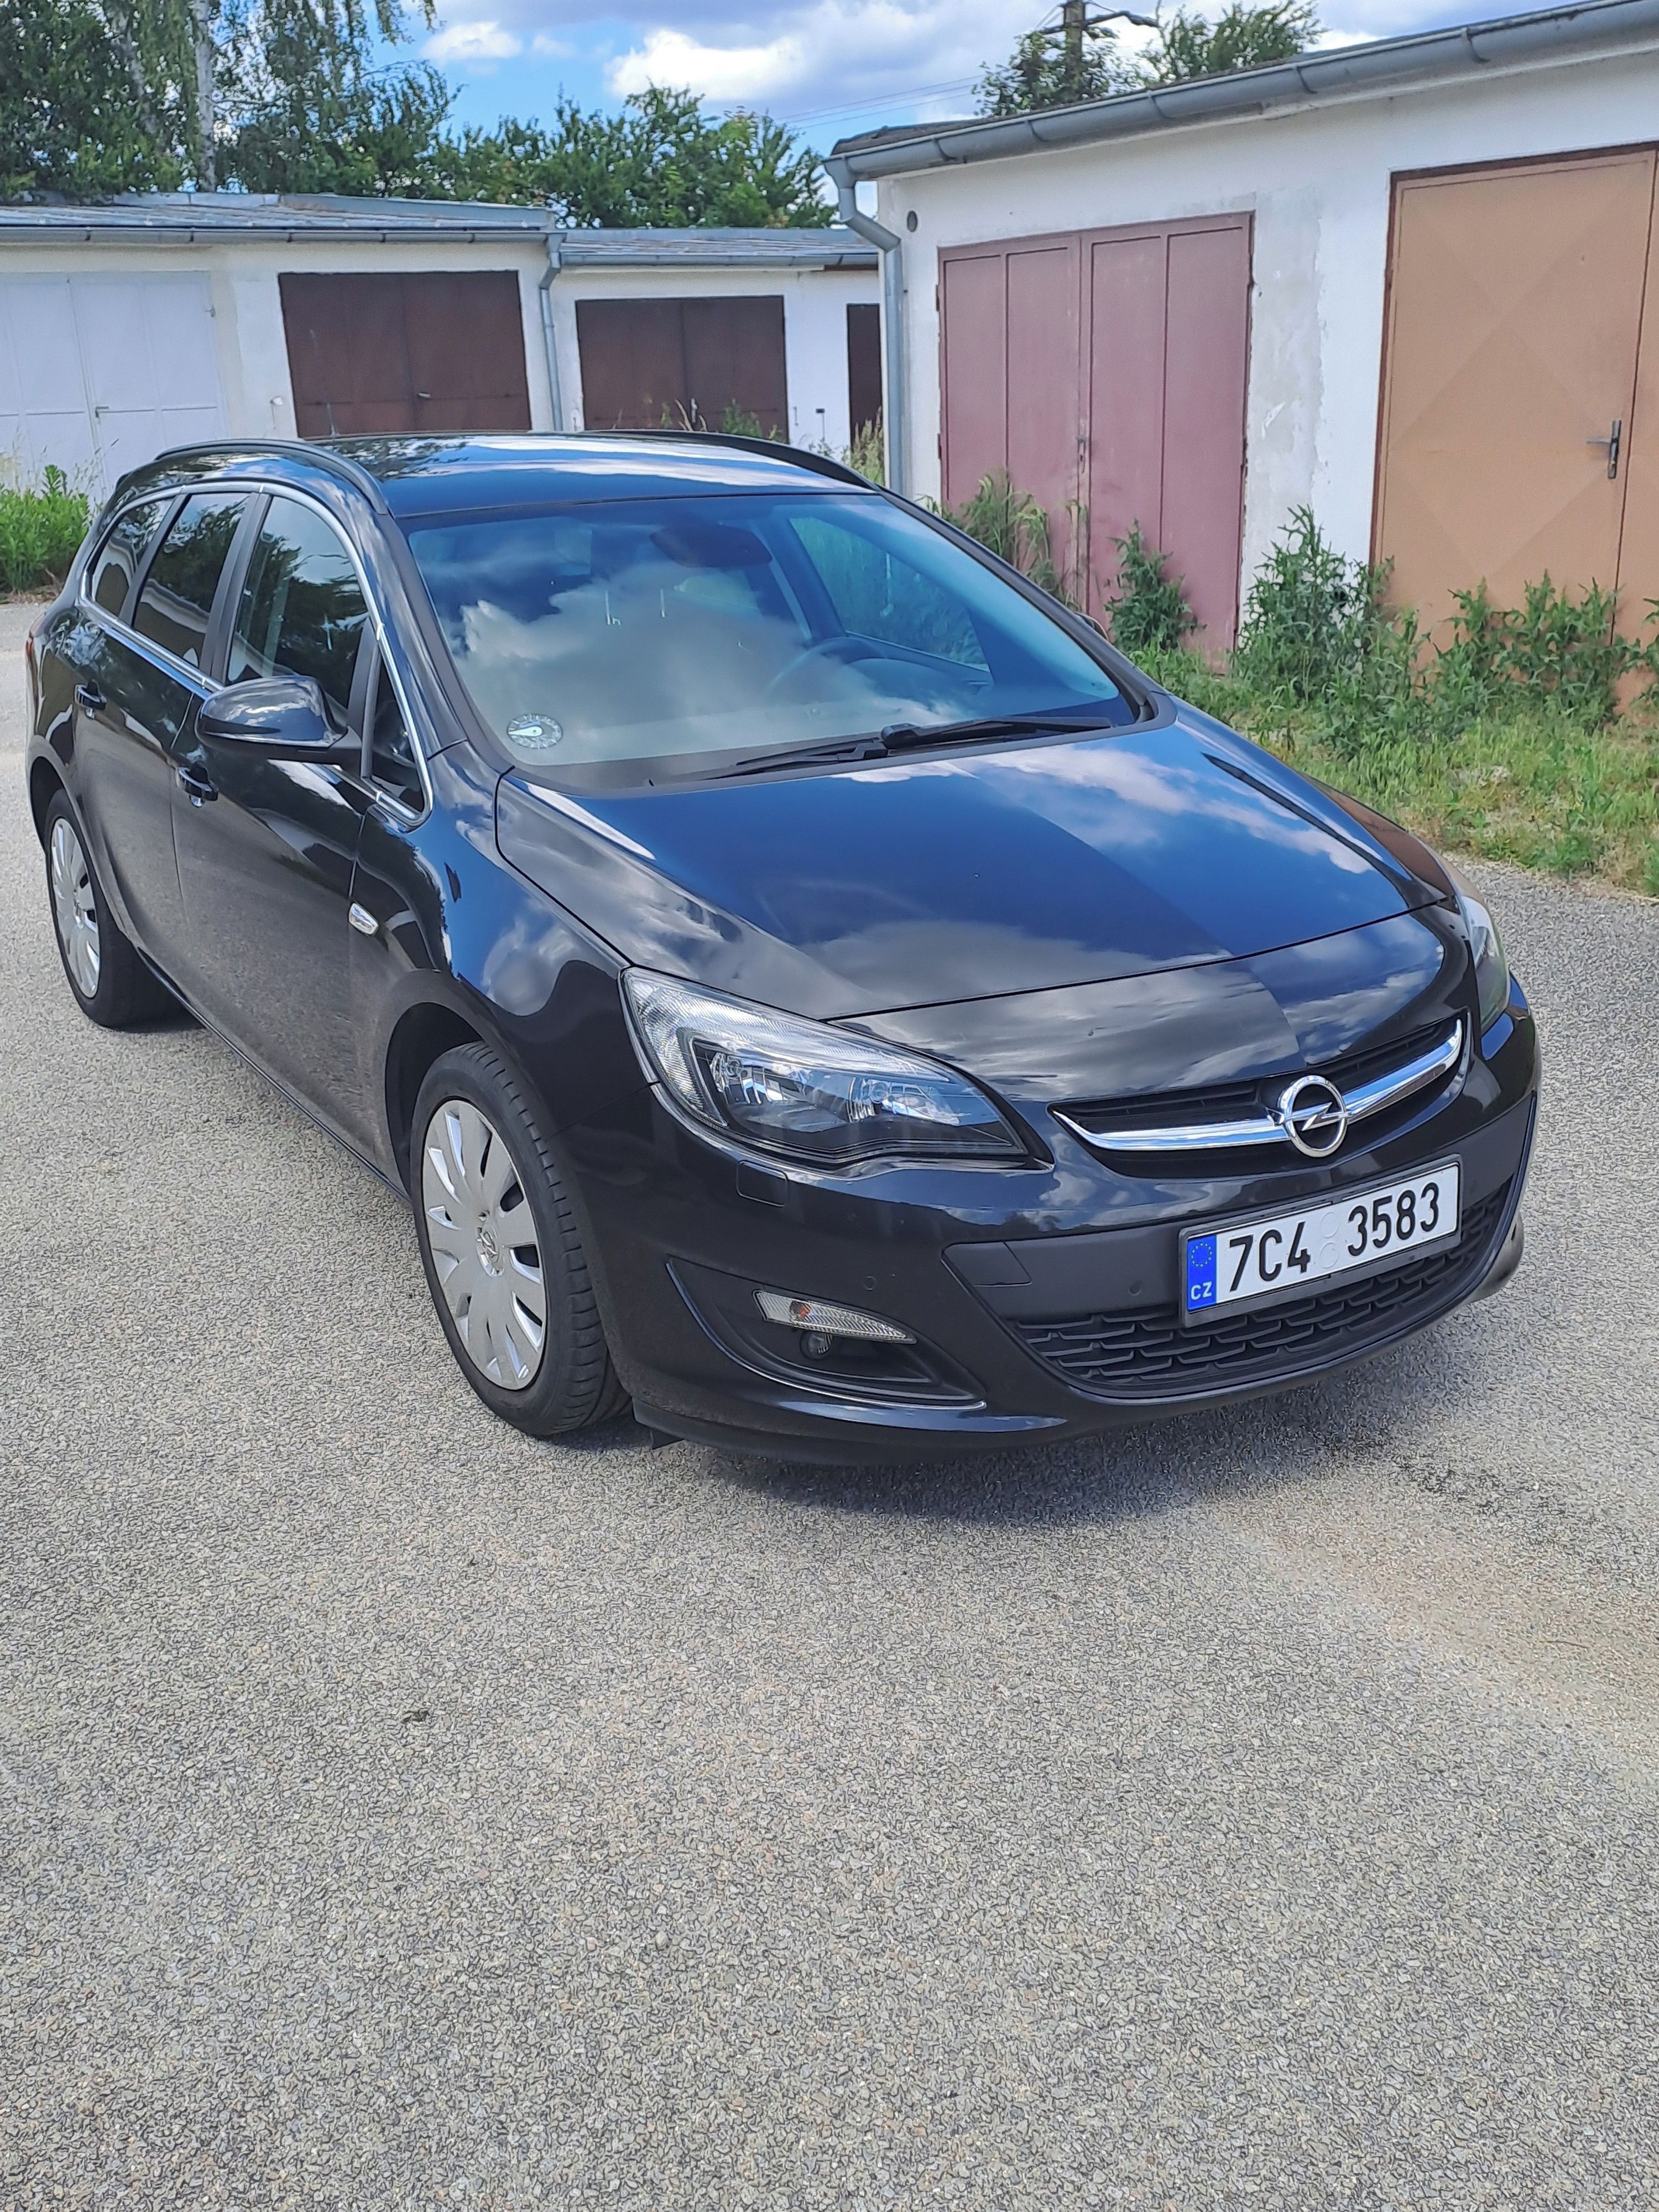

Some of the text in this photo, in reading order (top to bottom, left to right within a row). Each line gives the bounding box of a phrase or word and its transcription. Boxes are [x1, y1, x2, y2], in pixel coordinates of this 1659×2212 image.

[1229, 1182, 1439, 1292] 7C4 3583
[1191, 1281, 1212, 1300] CZ
